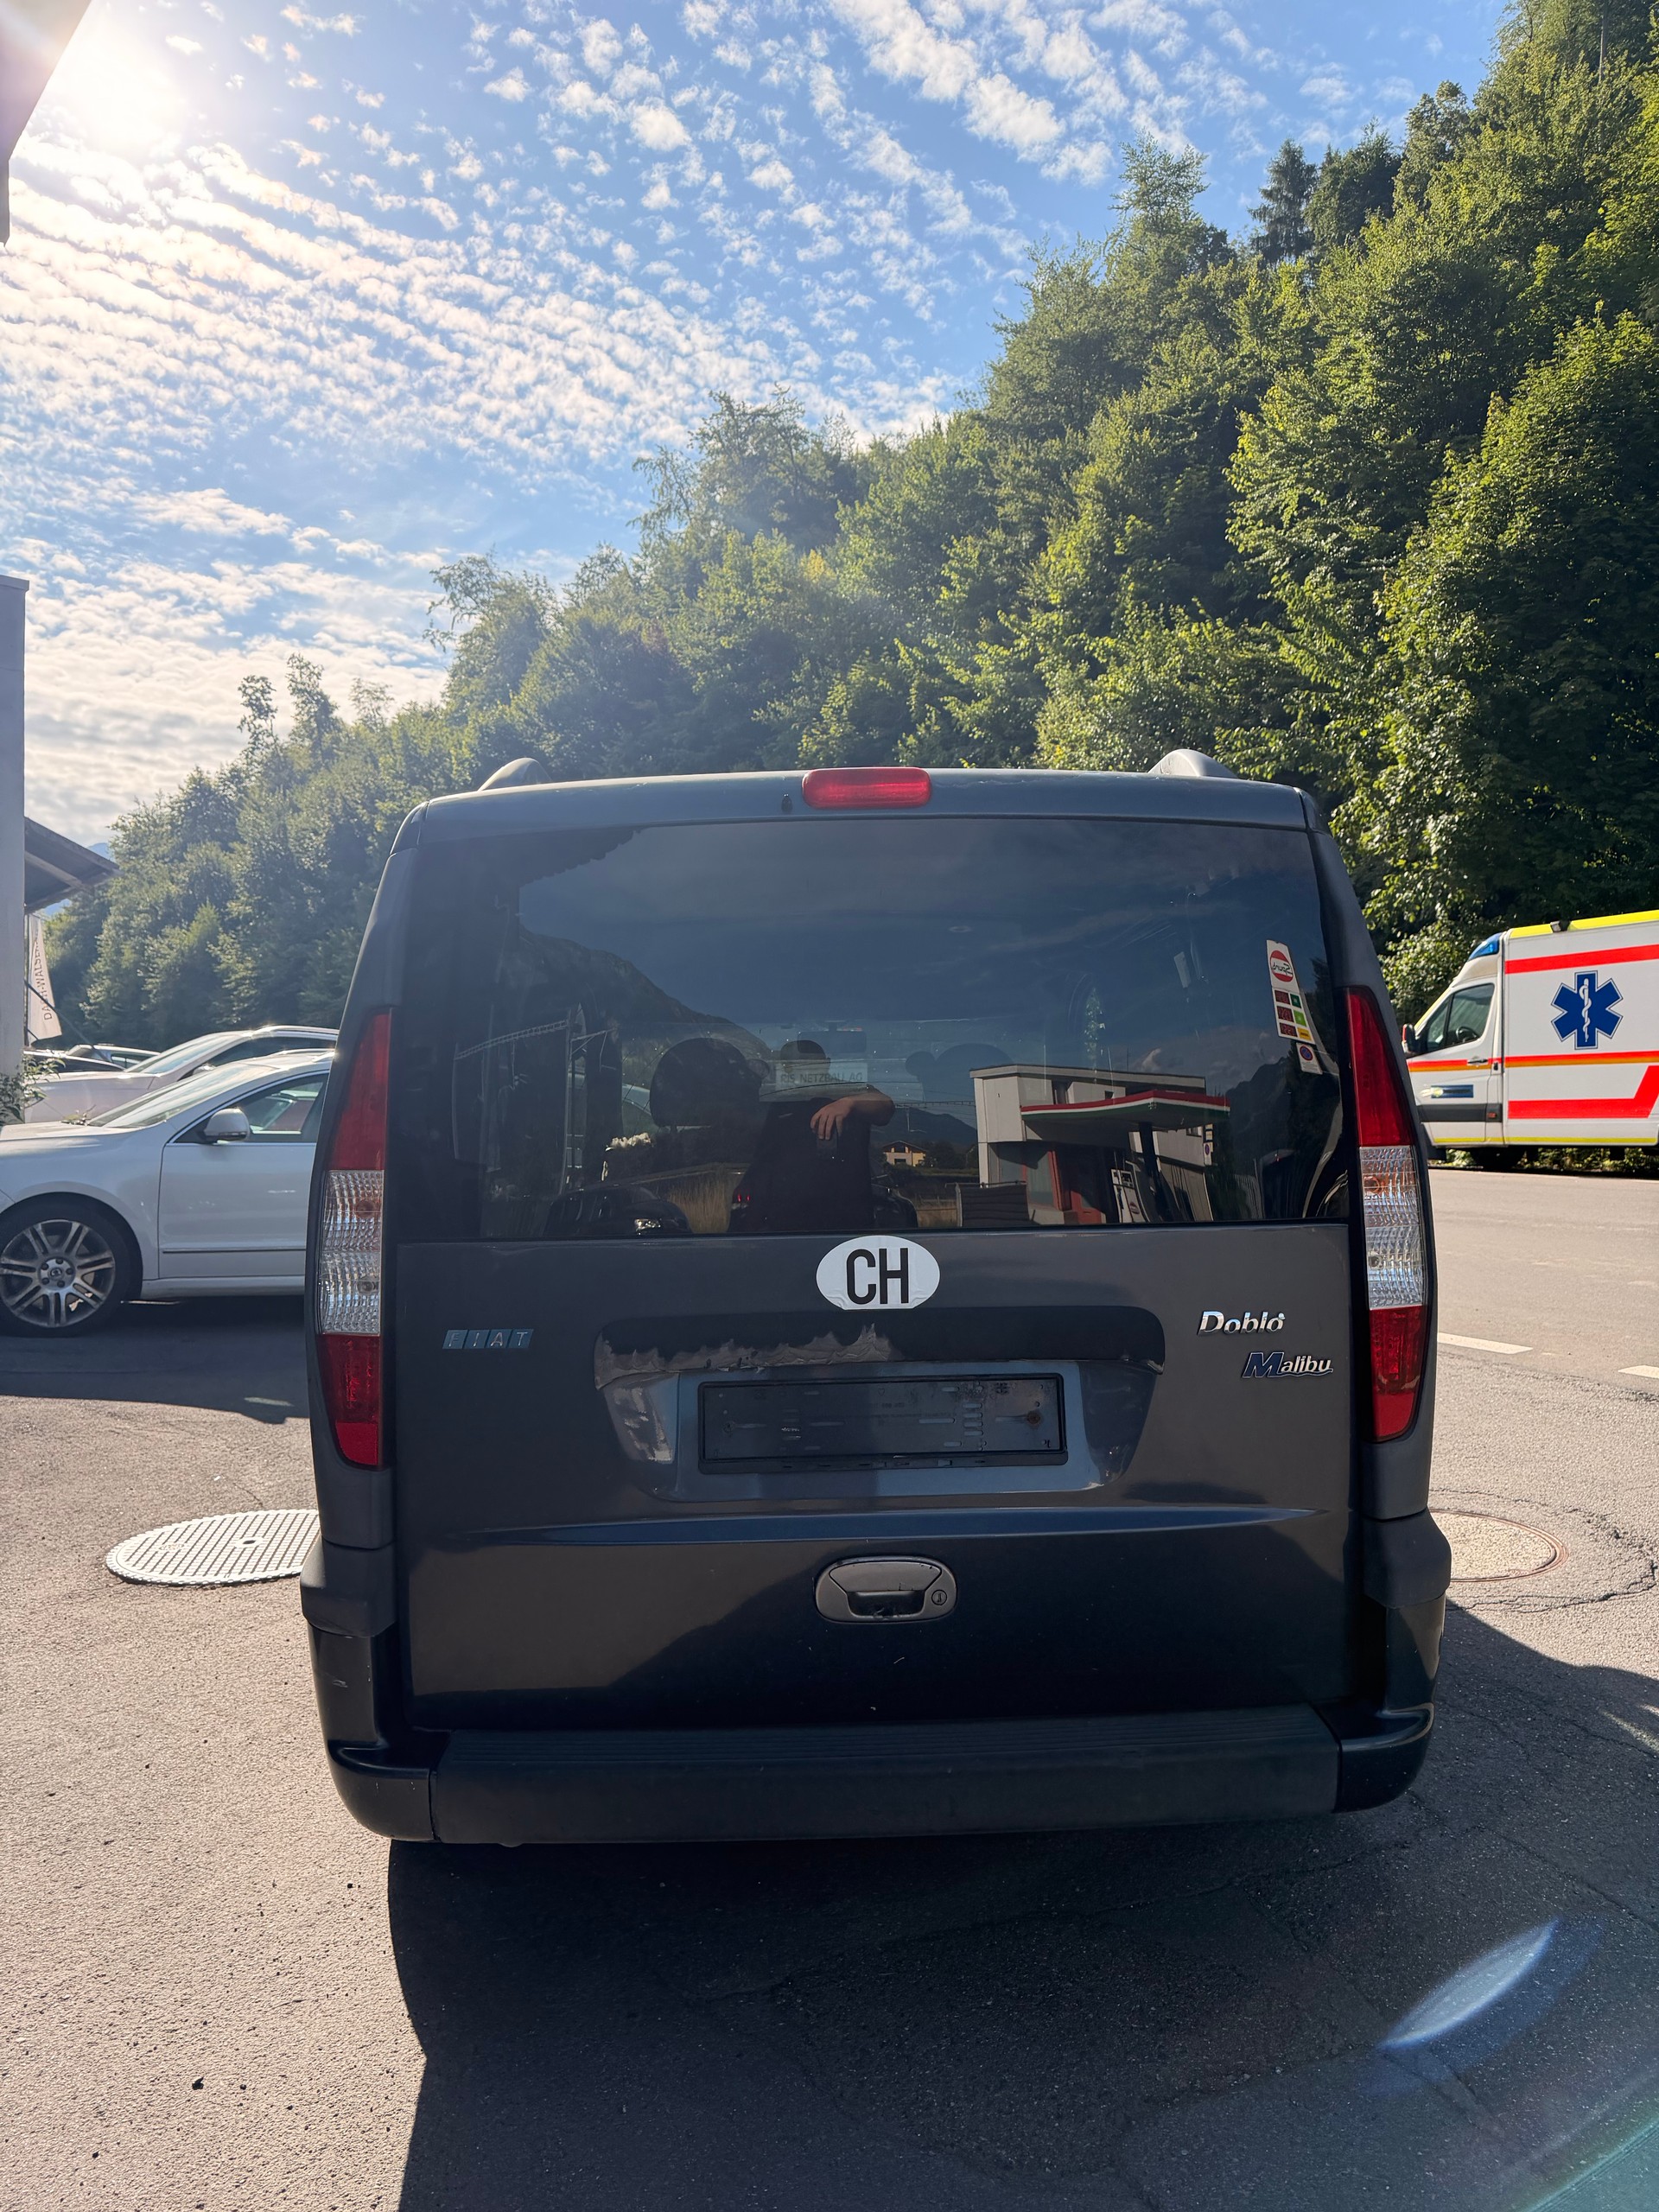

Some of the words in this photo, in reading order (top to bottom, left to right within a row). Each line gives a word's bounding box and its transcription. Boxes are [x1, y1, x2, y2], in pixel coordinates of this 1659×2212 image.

[849, 1071, 863, 1082] AG
[846, 1248, 909, 1305] CH
[446, 1331, 531, 1348] FIAT
[1242, 1351, 1333, 1378] Malibu
